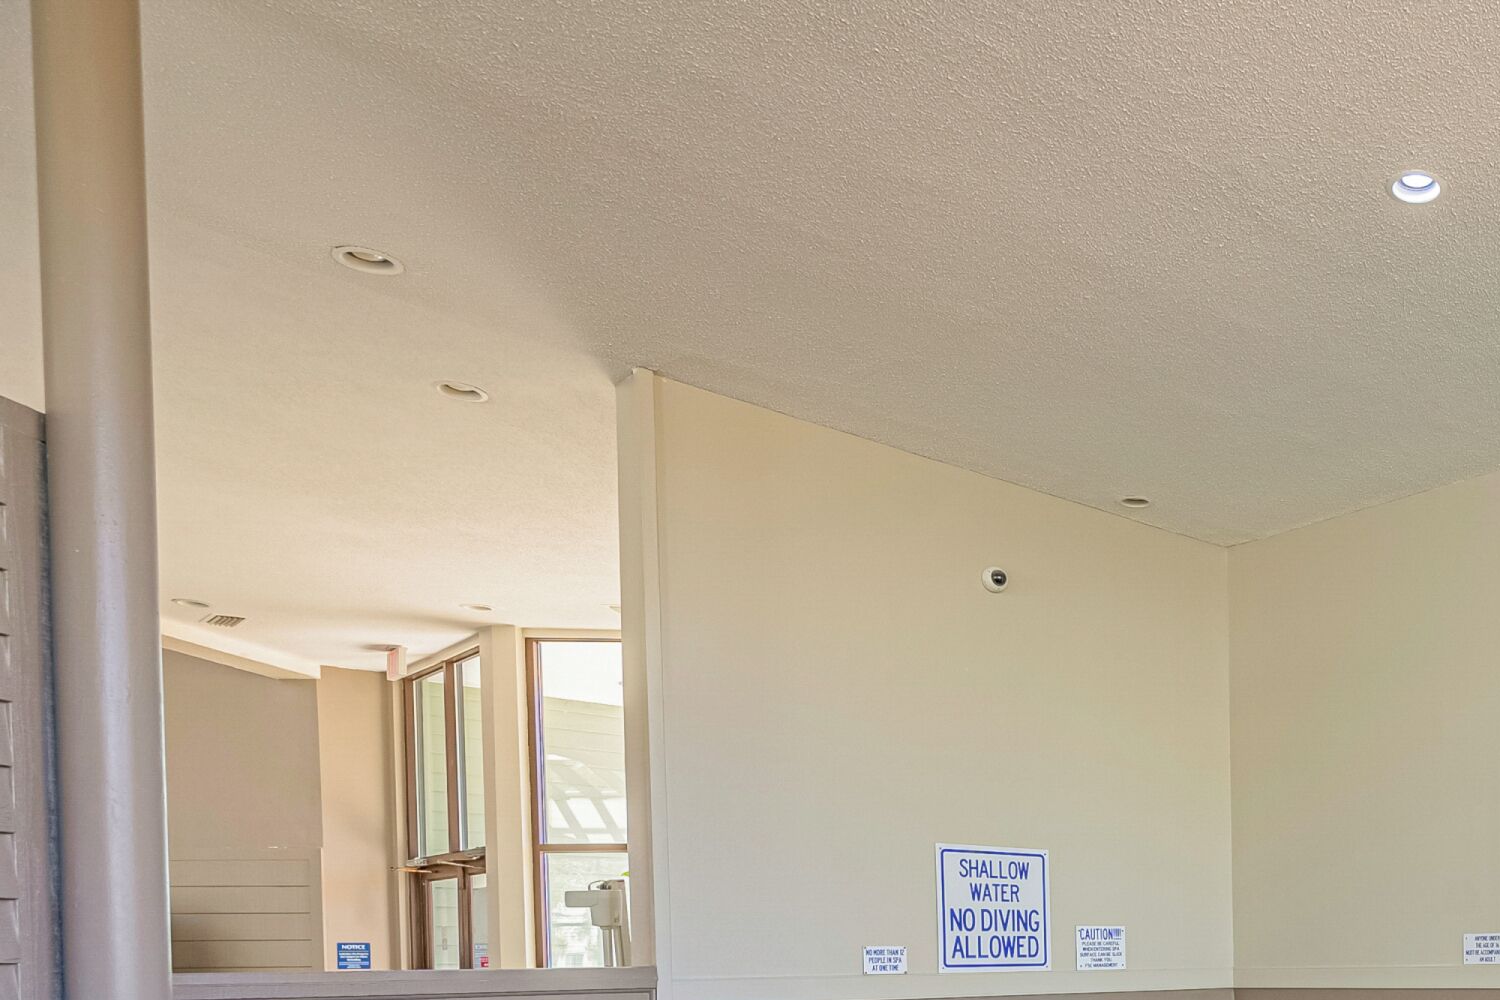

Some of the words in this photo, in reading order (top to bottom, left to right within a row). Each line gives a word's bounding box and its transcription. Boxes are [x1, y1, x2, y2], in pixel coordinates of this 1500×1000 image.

[959, 859, 1030, 880] SHALLOW
[970, 883, 1020, 902] WATER
[950, 908, 976, 932] NO
[981, 909, 1040, 932] DIVING
[952, 936, 1039, 958] ALLOWED
